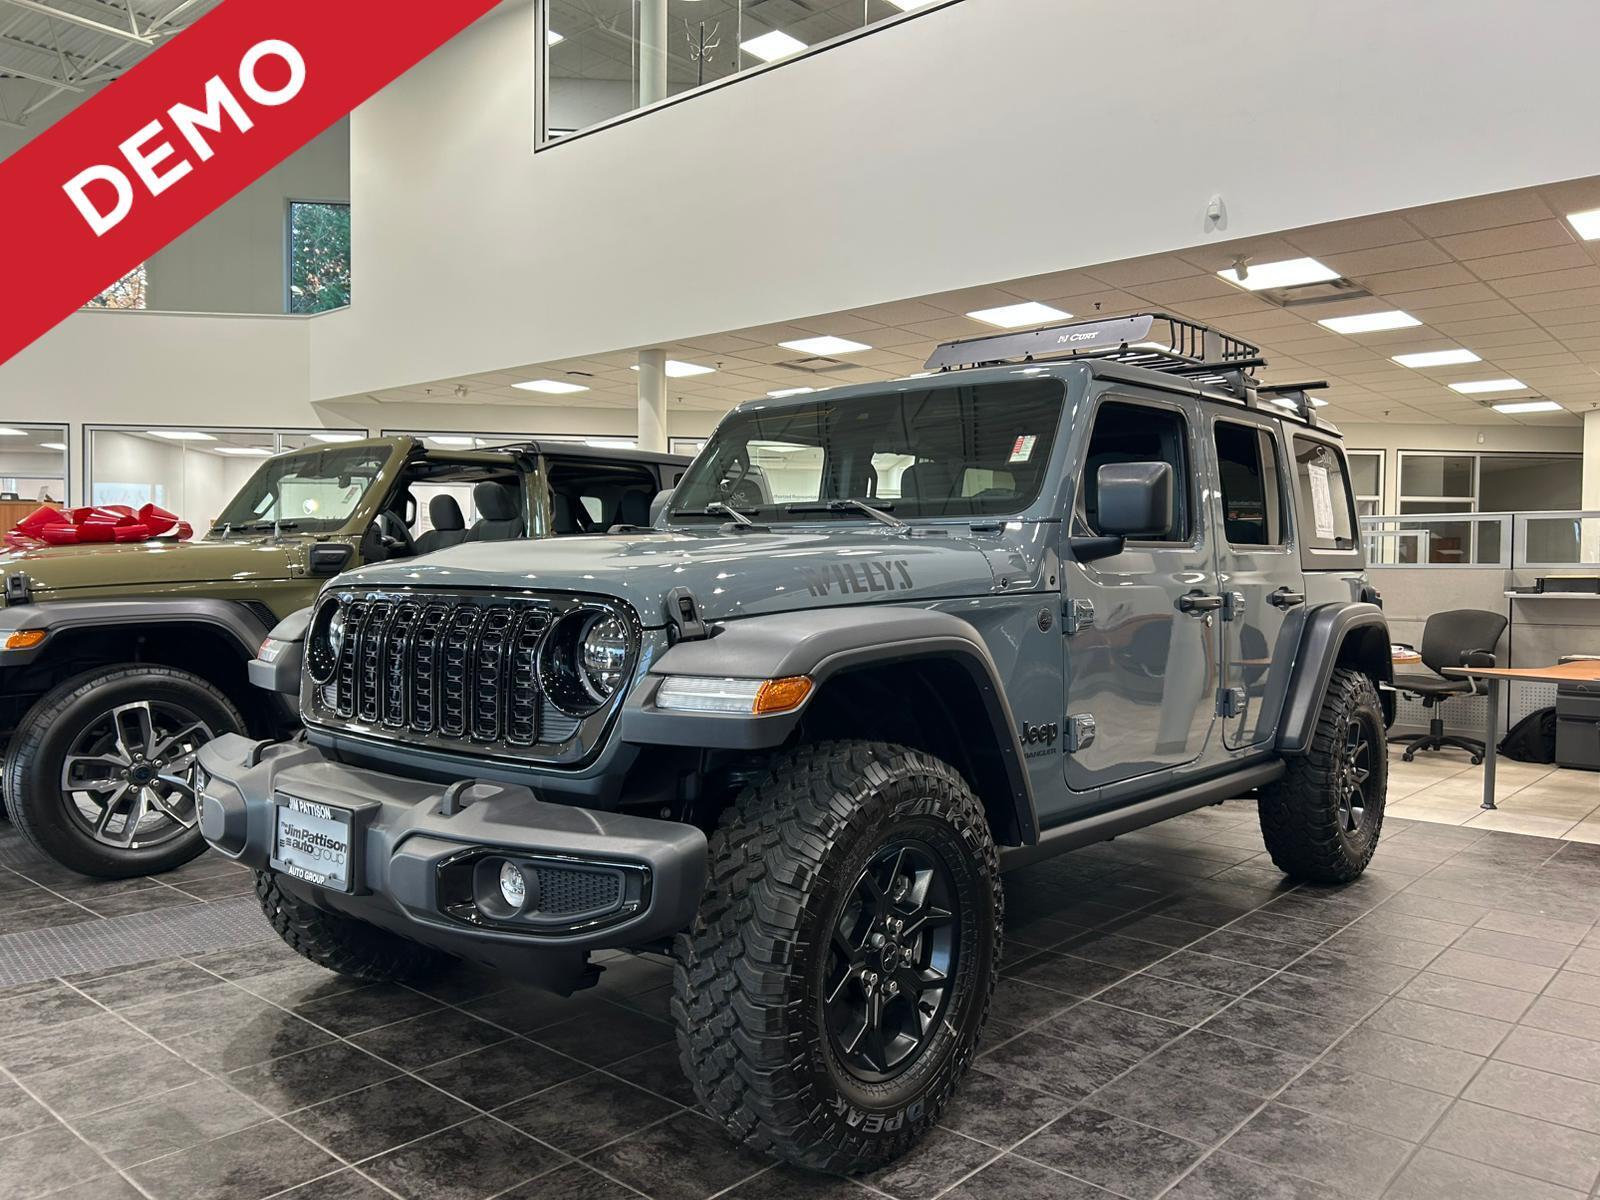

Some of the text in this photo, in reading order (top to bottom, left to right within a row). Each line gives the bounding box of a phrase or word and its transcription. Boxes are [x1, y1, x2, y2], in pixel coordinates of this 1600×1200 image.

[803, 560, 913, 597] WILLYS
[1019, 720, 1059, 747] Jeep
[289, 797, 332, 820] JIM PATTISON
[288, 865, 325, 885] AUTO GROUP
